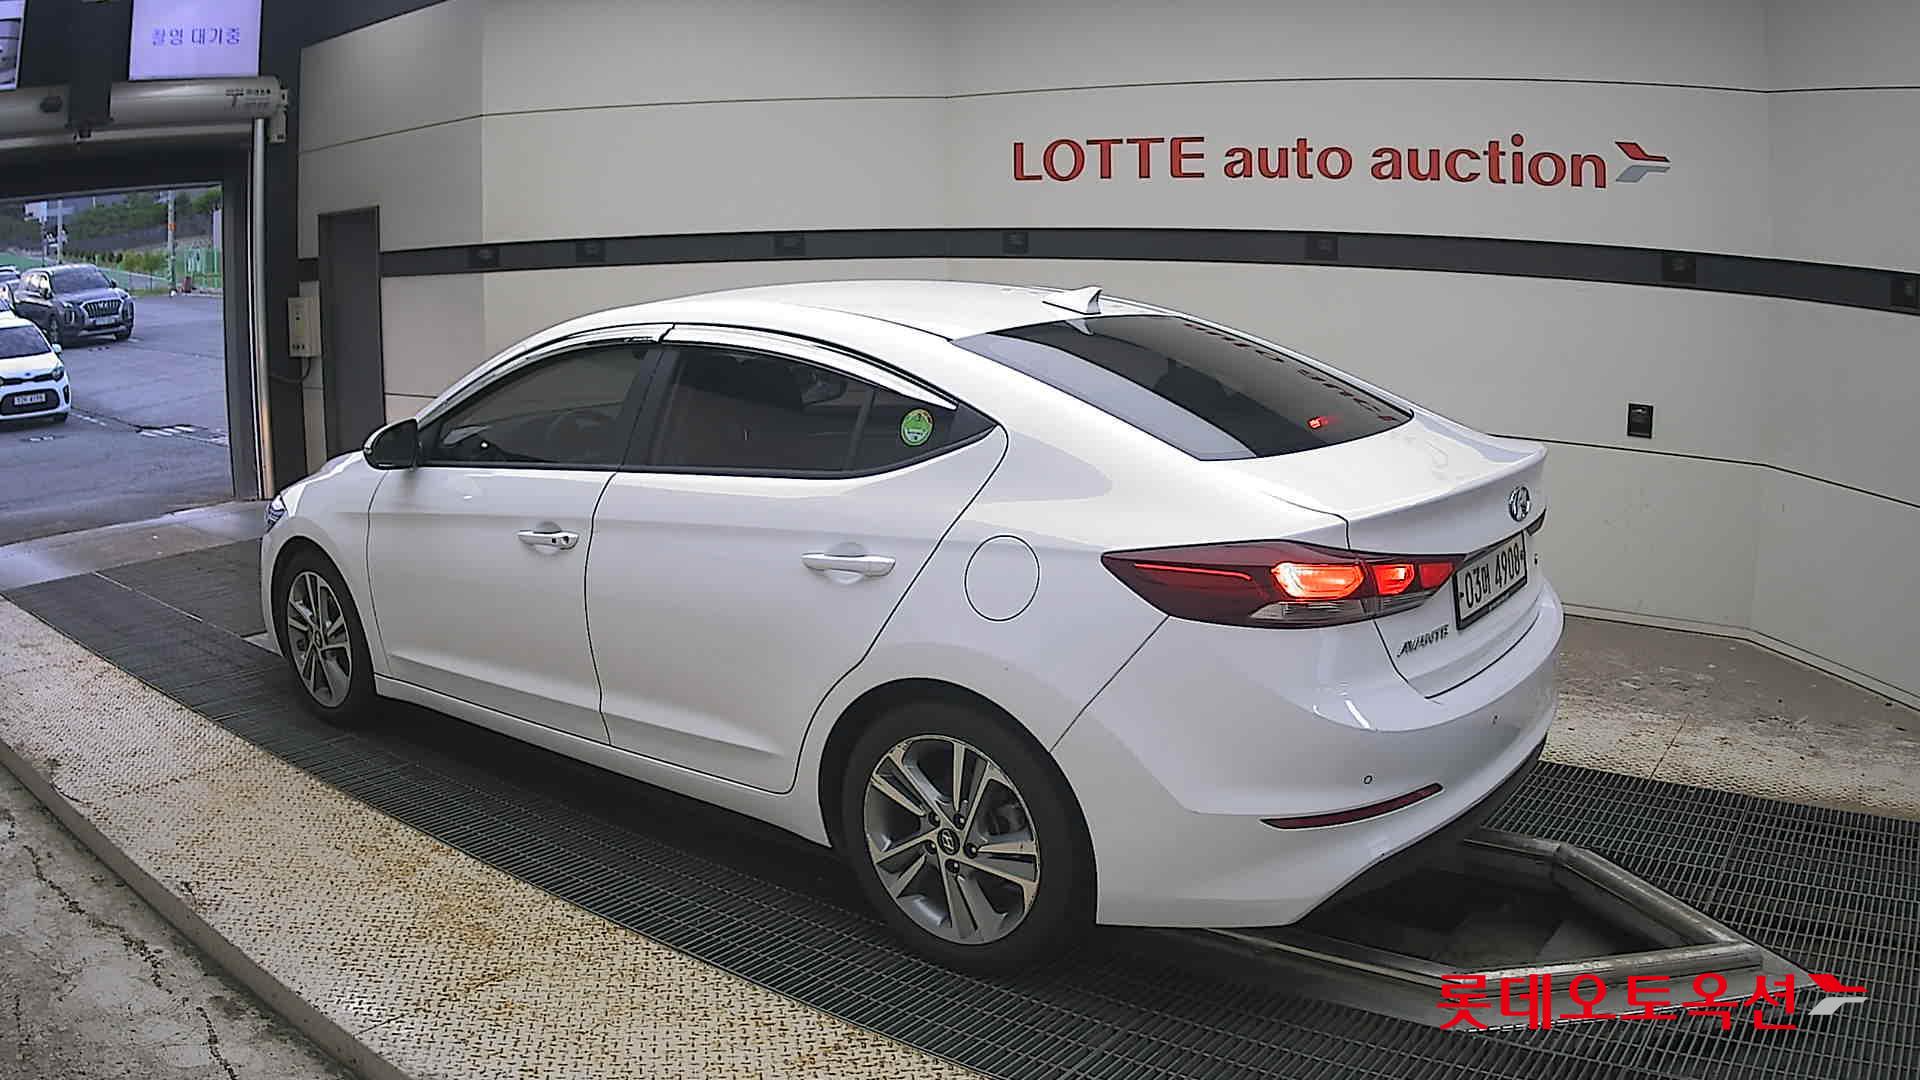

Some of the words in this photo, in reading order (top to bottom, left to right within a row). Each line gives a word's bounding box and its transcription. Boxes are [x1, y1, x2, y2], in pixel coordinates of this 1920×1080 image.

[191, 27, 240, 46] 대기중
[1013, 136, 1205, 181] LOTTE
[1223, 137, 1353, 180] auto
[1370, 133, 1607, 189] auction
[1495, 542, 1521, 588] 4908
[1397, 624, 1449, 658] AVANTE
